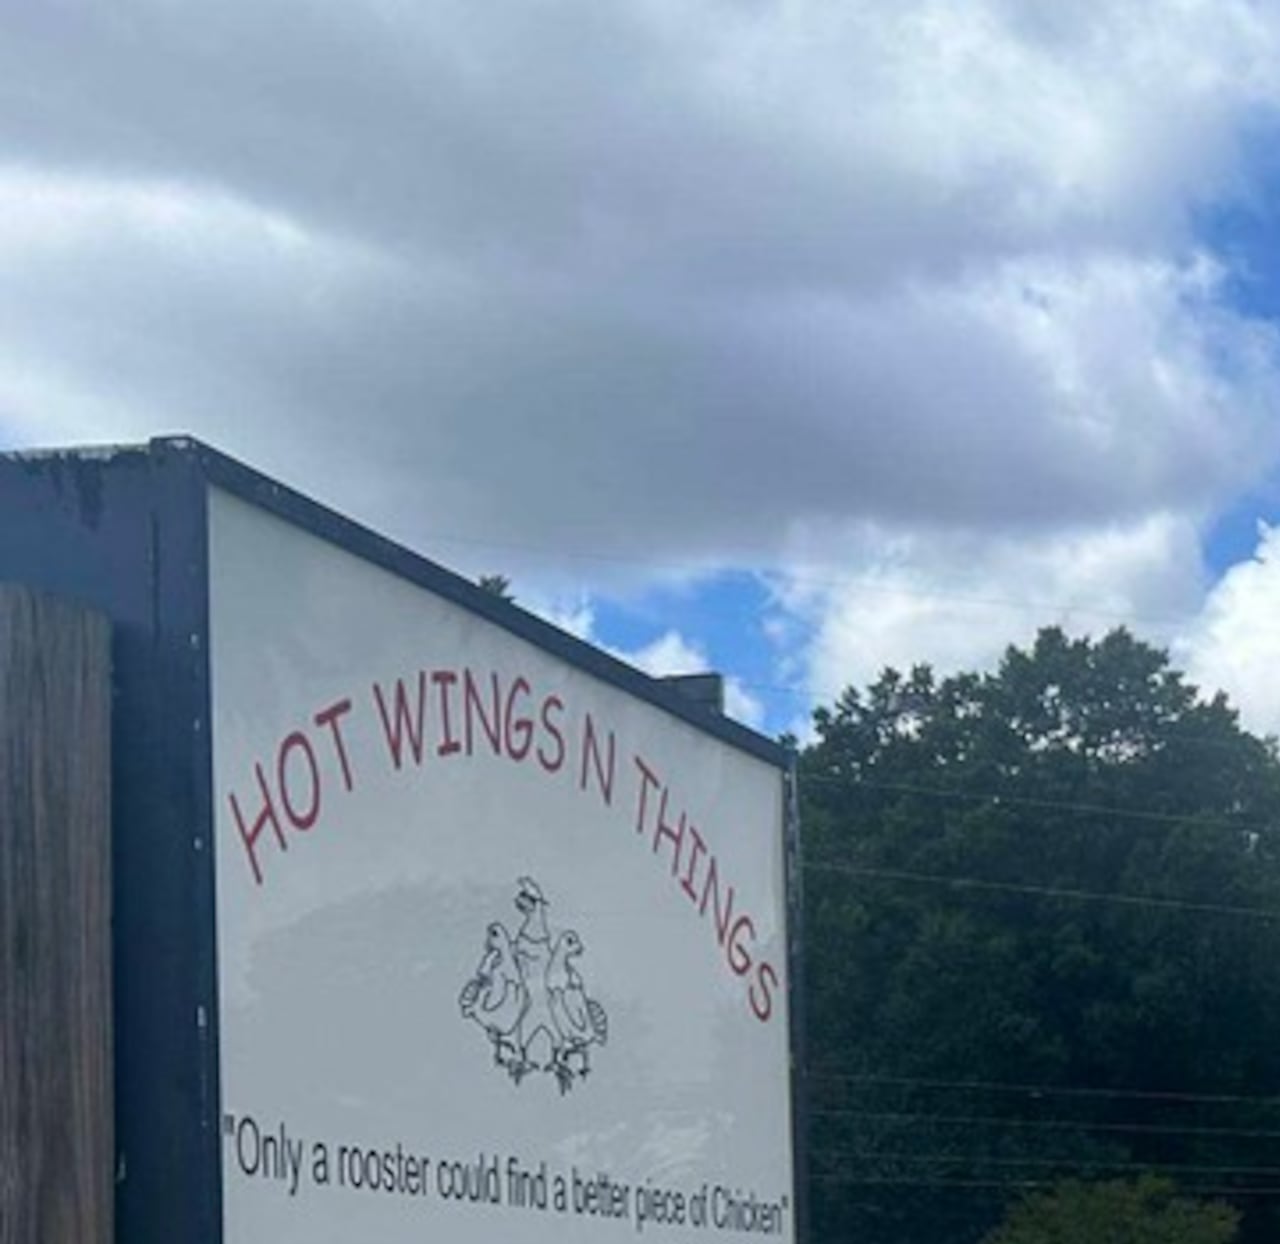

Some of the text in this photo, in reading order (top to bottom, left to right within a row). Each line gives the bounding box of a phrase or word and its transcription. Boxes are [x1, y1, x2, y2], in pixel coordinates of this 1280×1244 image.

[229, 667, 778, 1022] HOT WINGS N THINGS
[223, 1114, 303, 1197] "Only
[312, 1142, 330, 1185] a
[339, 1143, 431, 1197] rooster
[436, 1152, 501, 1204] could
[506, 1156, 548, 1211] find
[553, 1174, 568, 1213] a
[571, 1166, 630, 1219] better
[636, 1176, 687, 1233] piece
[689, 1183, 709, 1229] of
